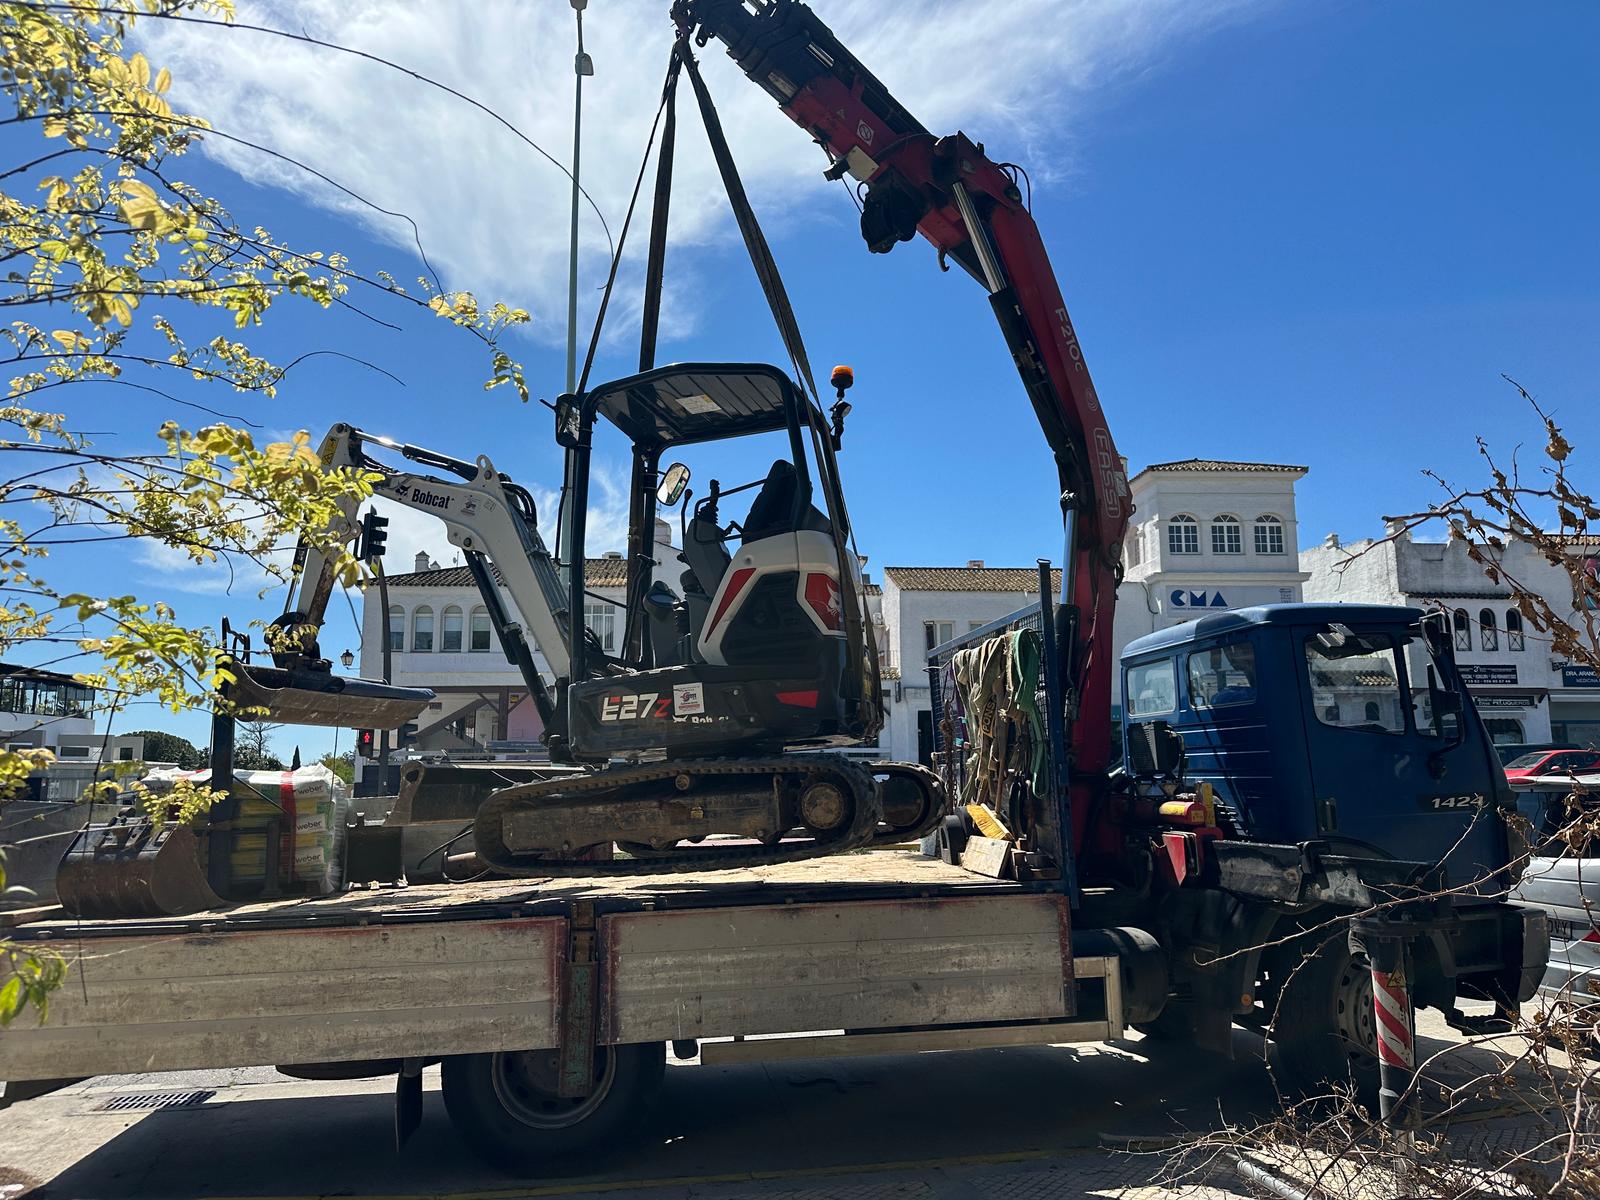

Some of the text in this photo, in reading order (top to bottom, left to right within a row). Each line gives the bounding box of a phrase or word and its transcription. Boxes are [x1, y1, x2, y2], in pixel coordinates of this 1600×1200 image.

[1096, 434, 1119, 511] FASSI
[412, 488, 451, 510] Bobcat
[1170, 589, 1228, 607] CMA
[297, 784, 323, 795] weber
[1432, 795, 1484, 809] 1424
[296, 820, 322, 831] weber
[295, 853, 321, 864] weber
